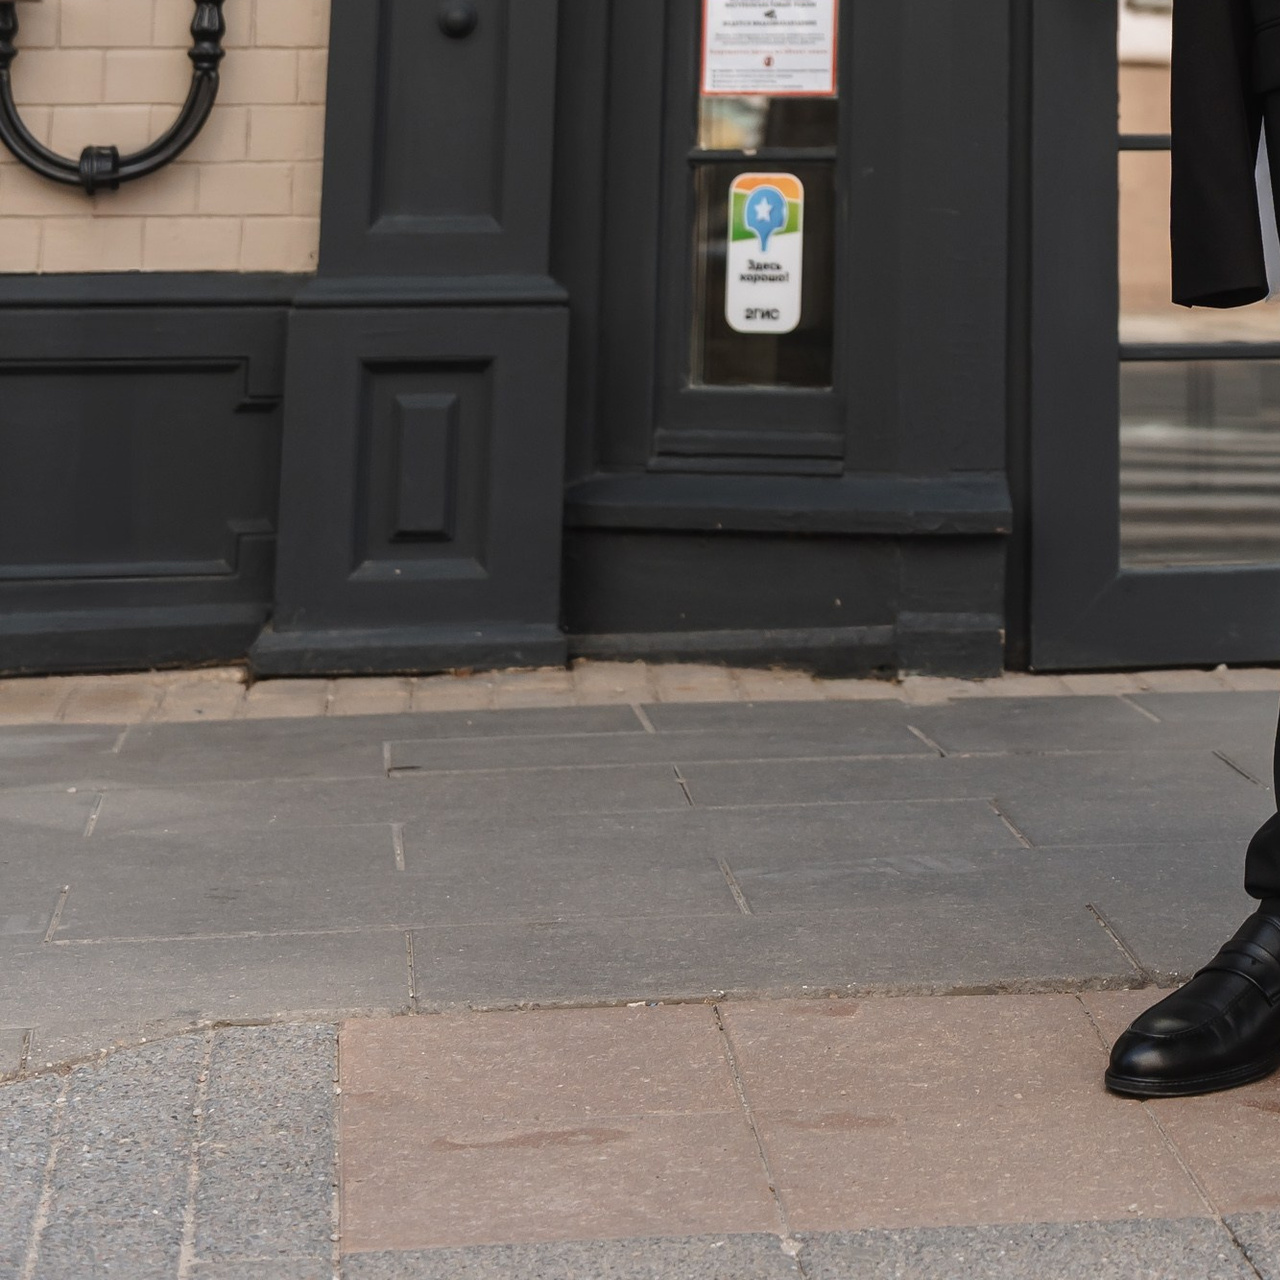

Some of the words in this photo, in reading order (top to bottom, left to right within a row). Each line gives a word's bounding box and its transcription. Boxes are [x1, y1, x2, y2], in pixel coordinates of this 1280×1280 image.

[748, 259, 782, 272] Здесь
[739, 271, 790, 284] хорошо!
[745, 307, 780, 320] 2ГИС
